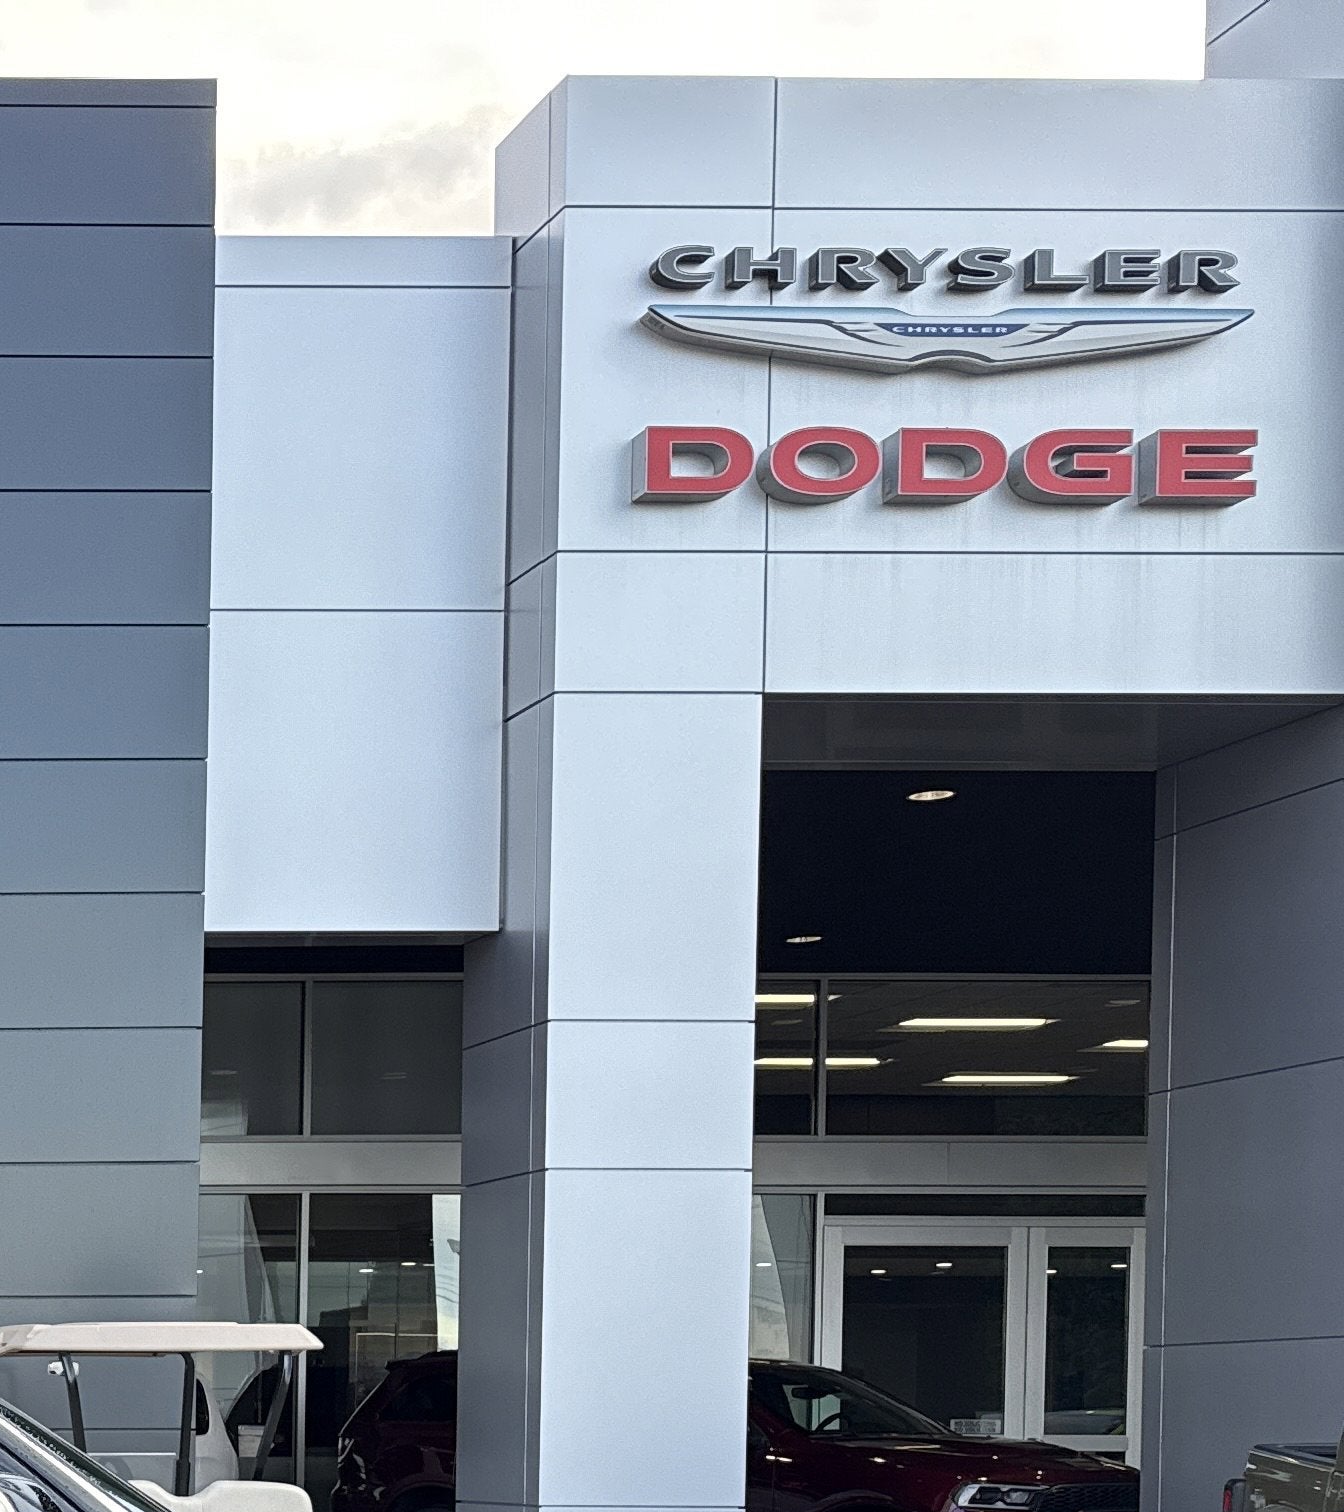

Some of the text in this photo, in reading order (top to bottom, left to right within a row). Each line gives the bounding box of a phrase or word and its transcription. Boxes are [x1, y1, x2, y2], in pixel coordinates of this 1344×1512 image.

[649, 245, 1242, 293] CHRYSLER
[891, 326, 1009, 334] CHRYSLER
[631, 426, 1259, 505] DODGE
